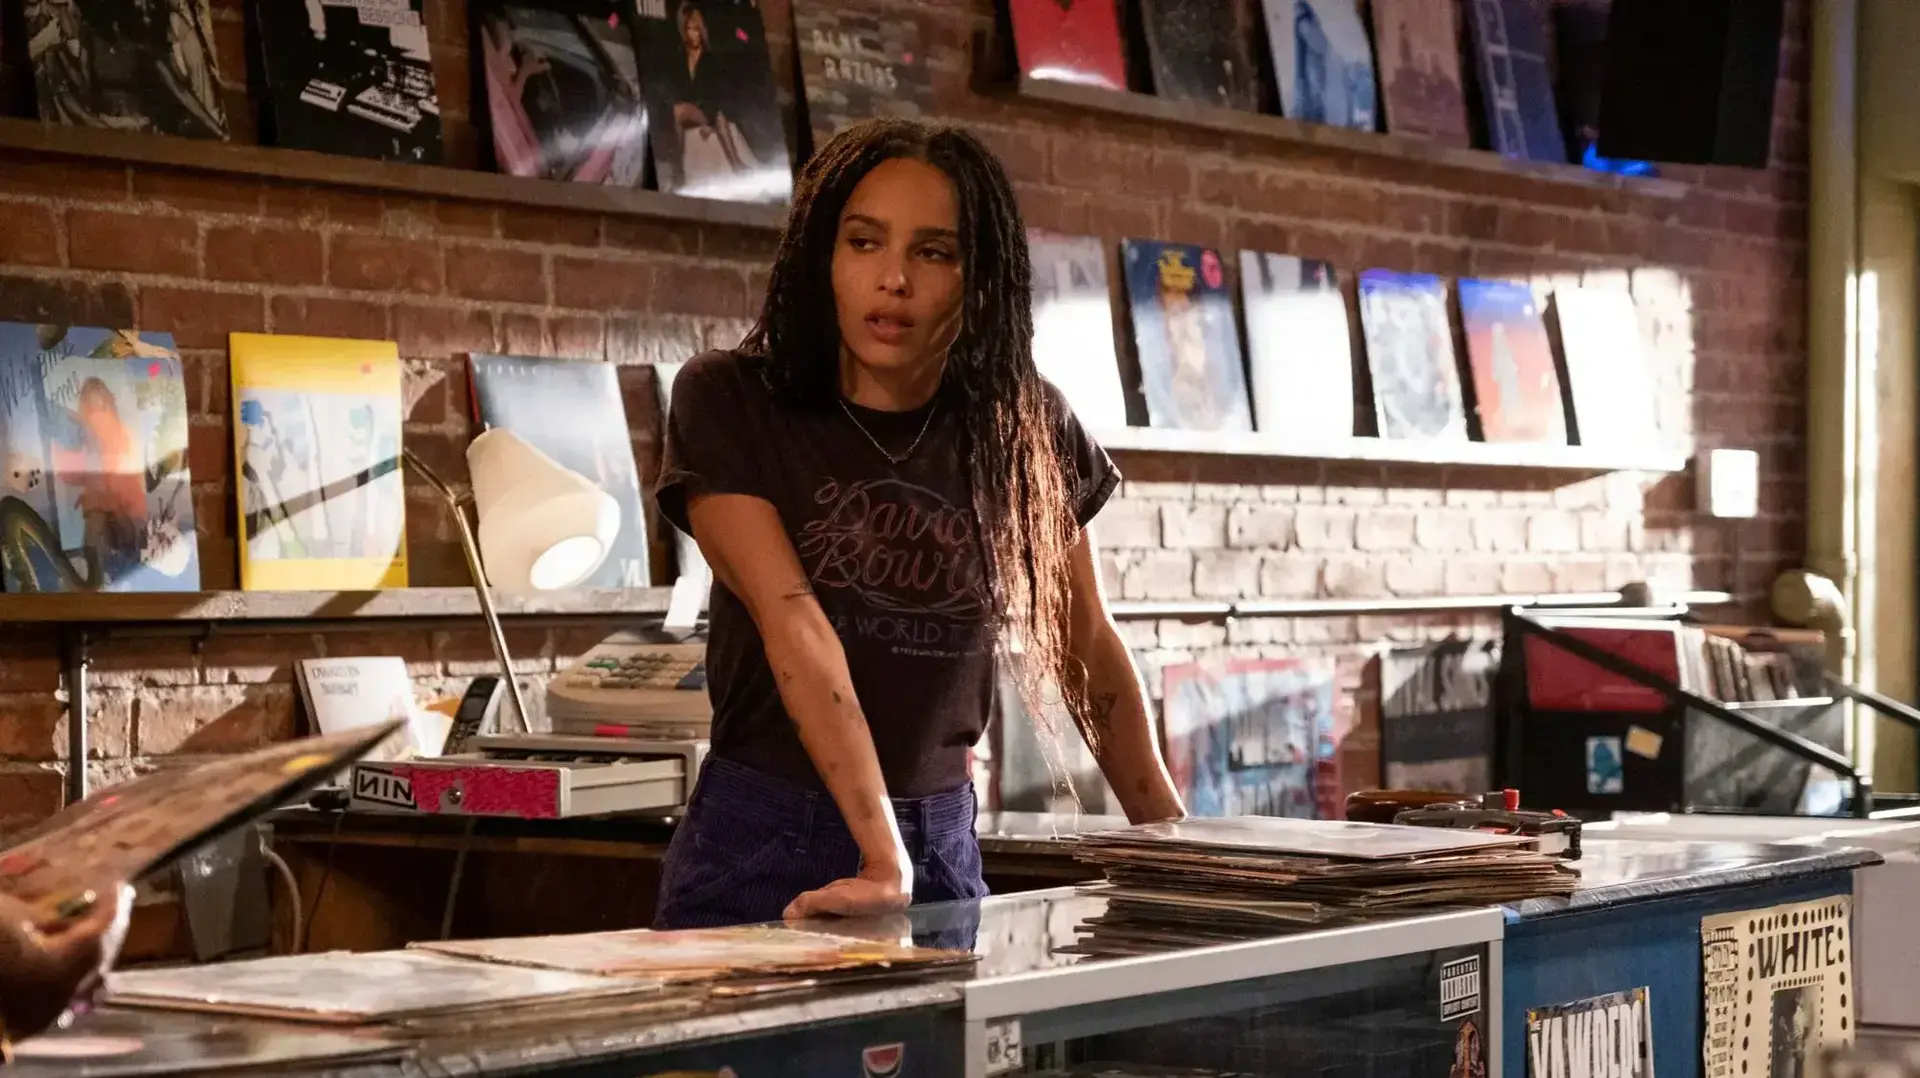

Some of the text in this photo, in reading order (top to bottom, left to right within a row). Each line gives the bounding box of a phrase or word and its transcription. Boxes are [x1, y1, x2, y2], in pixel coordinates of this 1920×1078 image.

[855, 614, 942, 644] WORLD
[1757, 924, 1836, 980] WHITE
[1443, 961, 1478, 980] PARENTAL
